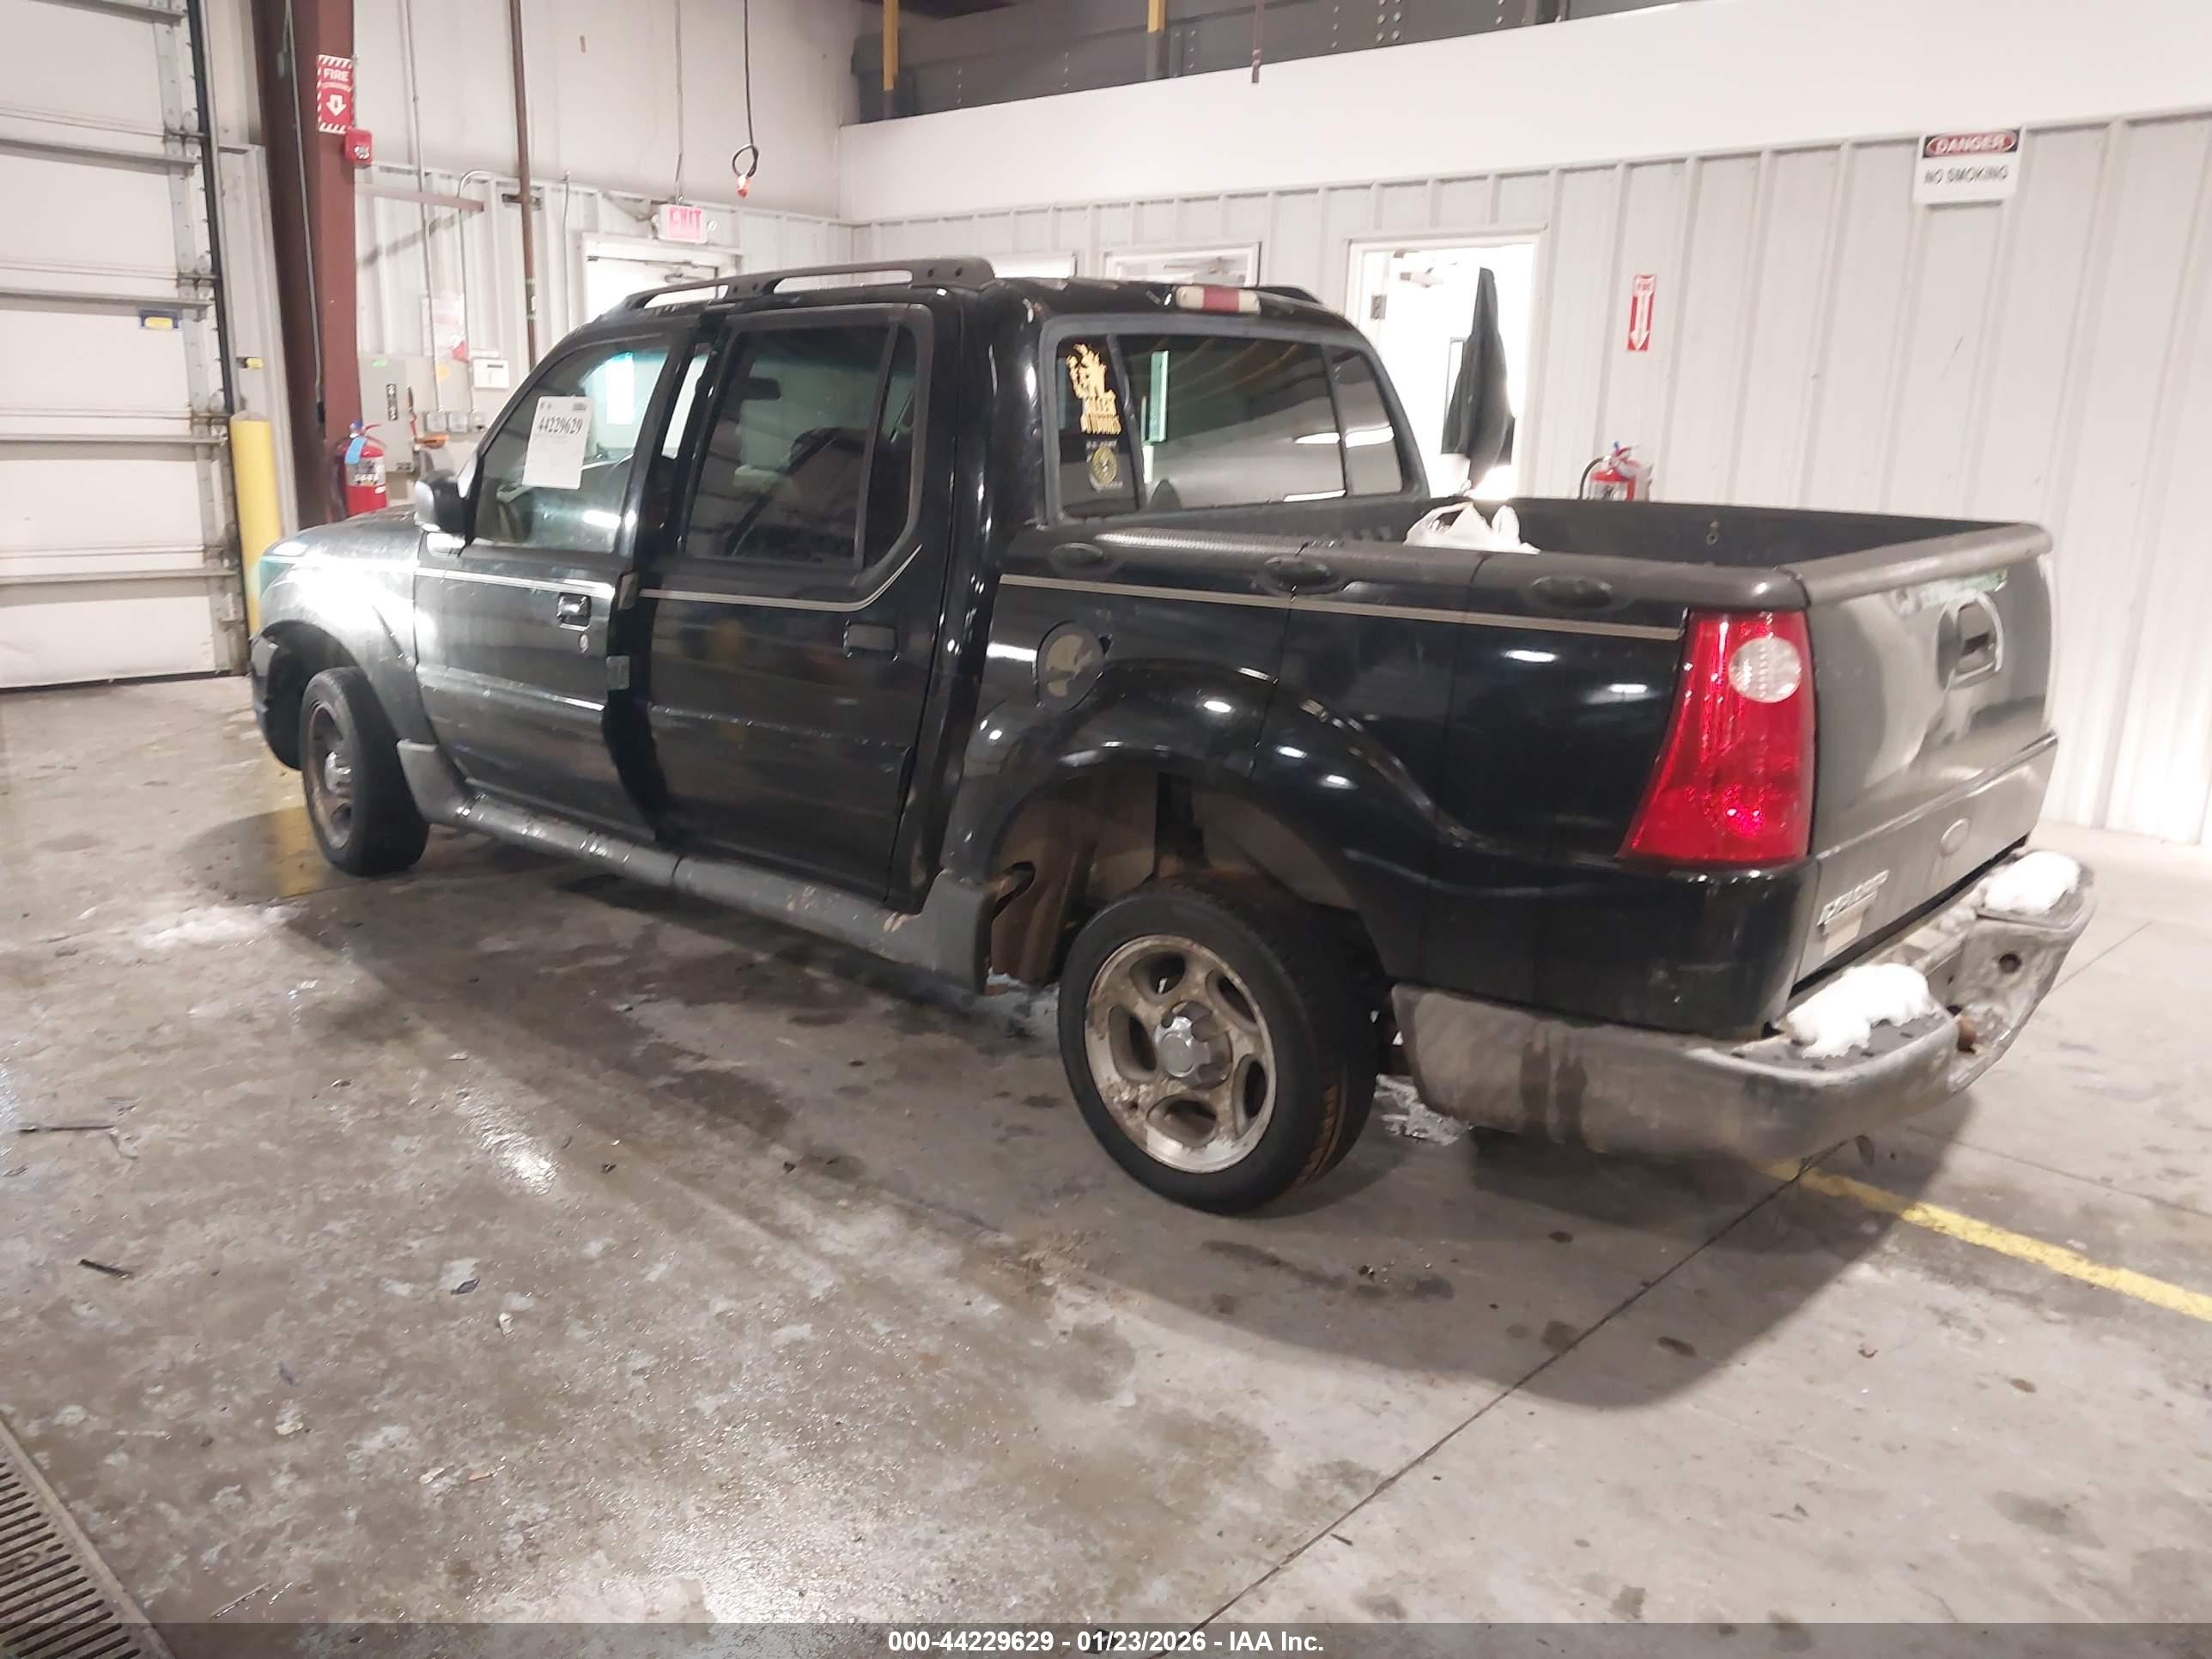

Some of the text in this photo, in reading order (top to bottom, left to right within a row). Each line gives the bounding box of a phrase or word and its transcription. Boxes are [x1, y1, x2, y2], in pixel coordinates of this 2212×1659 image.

[323, 68, 349, 82] FIRE
[1936, 135, 2006, 153] DANGER
[1925, 165, 2008, 184] NO SMOKING
[538, 416, 584, 434] 44229629
